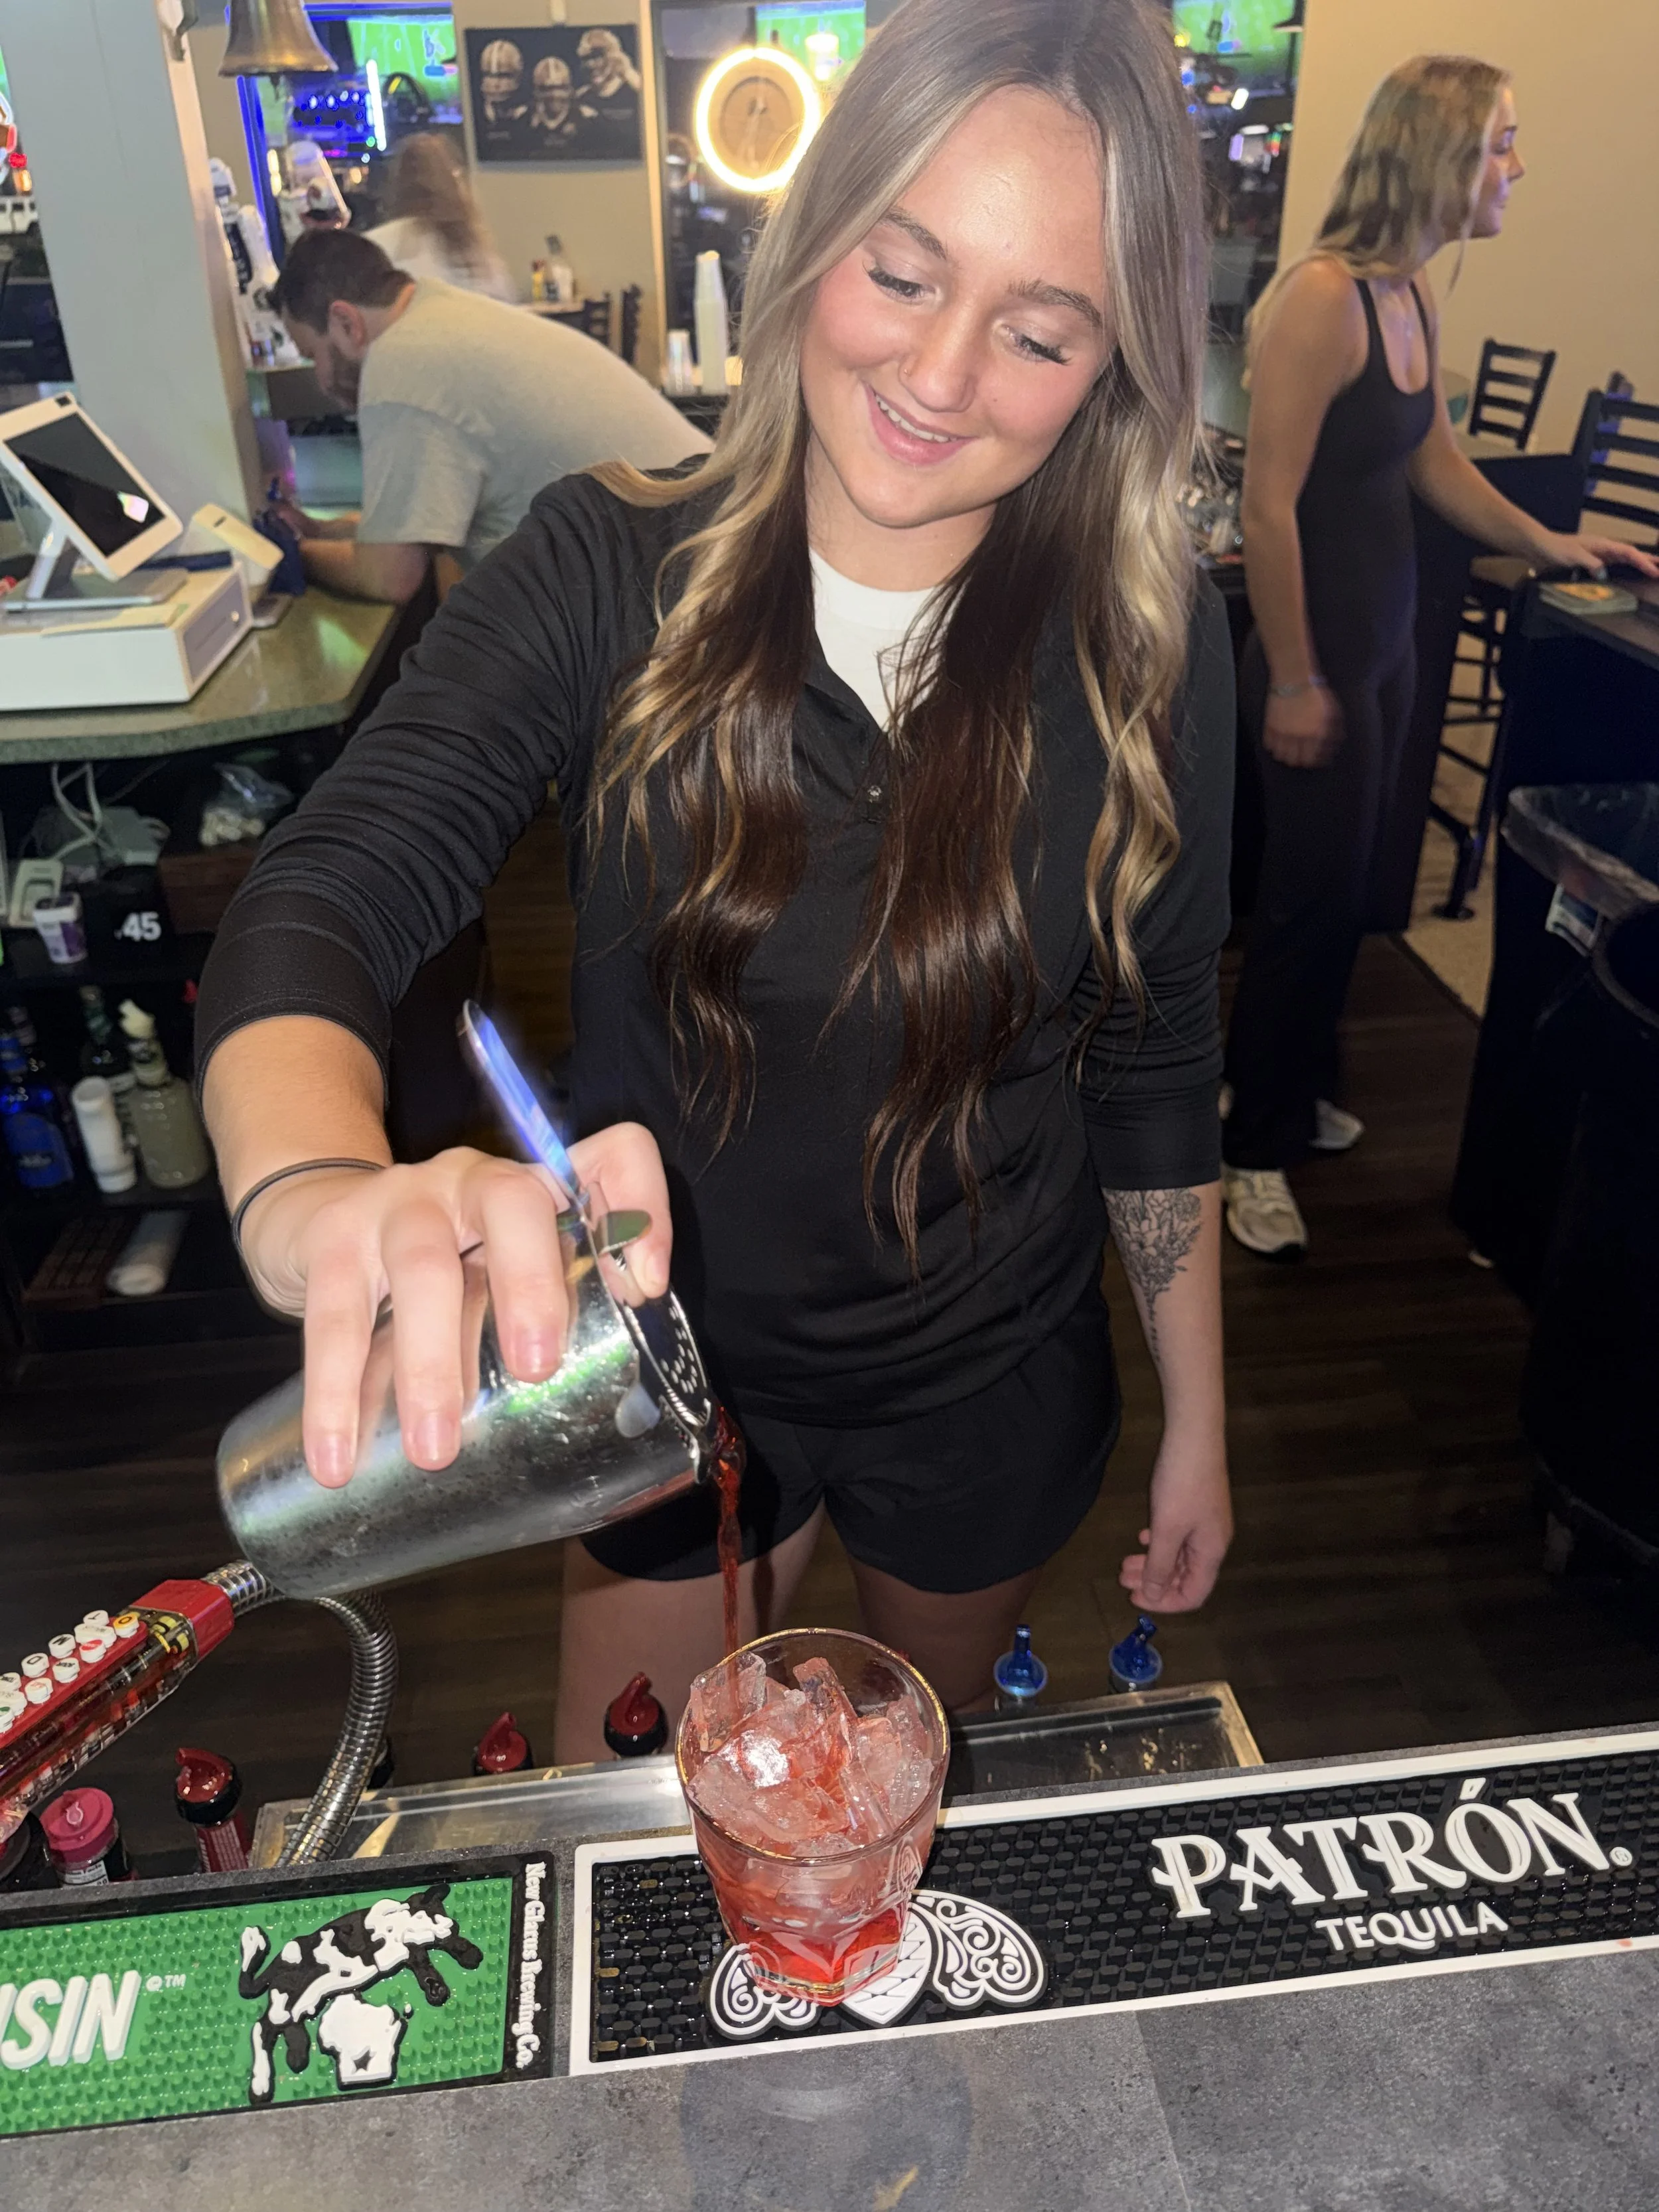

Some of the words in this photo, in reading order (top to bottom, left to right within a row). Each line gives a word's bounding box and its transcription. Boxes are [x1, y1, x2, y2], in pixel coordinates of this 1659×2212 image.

[122, 911, 162, 941] 45
[525, 1862, 546, 1900] New
[522, 1900, 545, 1960] Glarus
[1315, 1902, 1508, 1951] TEQUILA
[0, 1970, 141, 2069] SIN
[512, 1958, 543, 2037] Brewing
[516, 2033, 540, 2069] Co.
